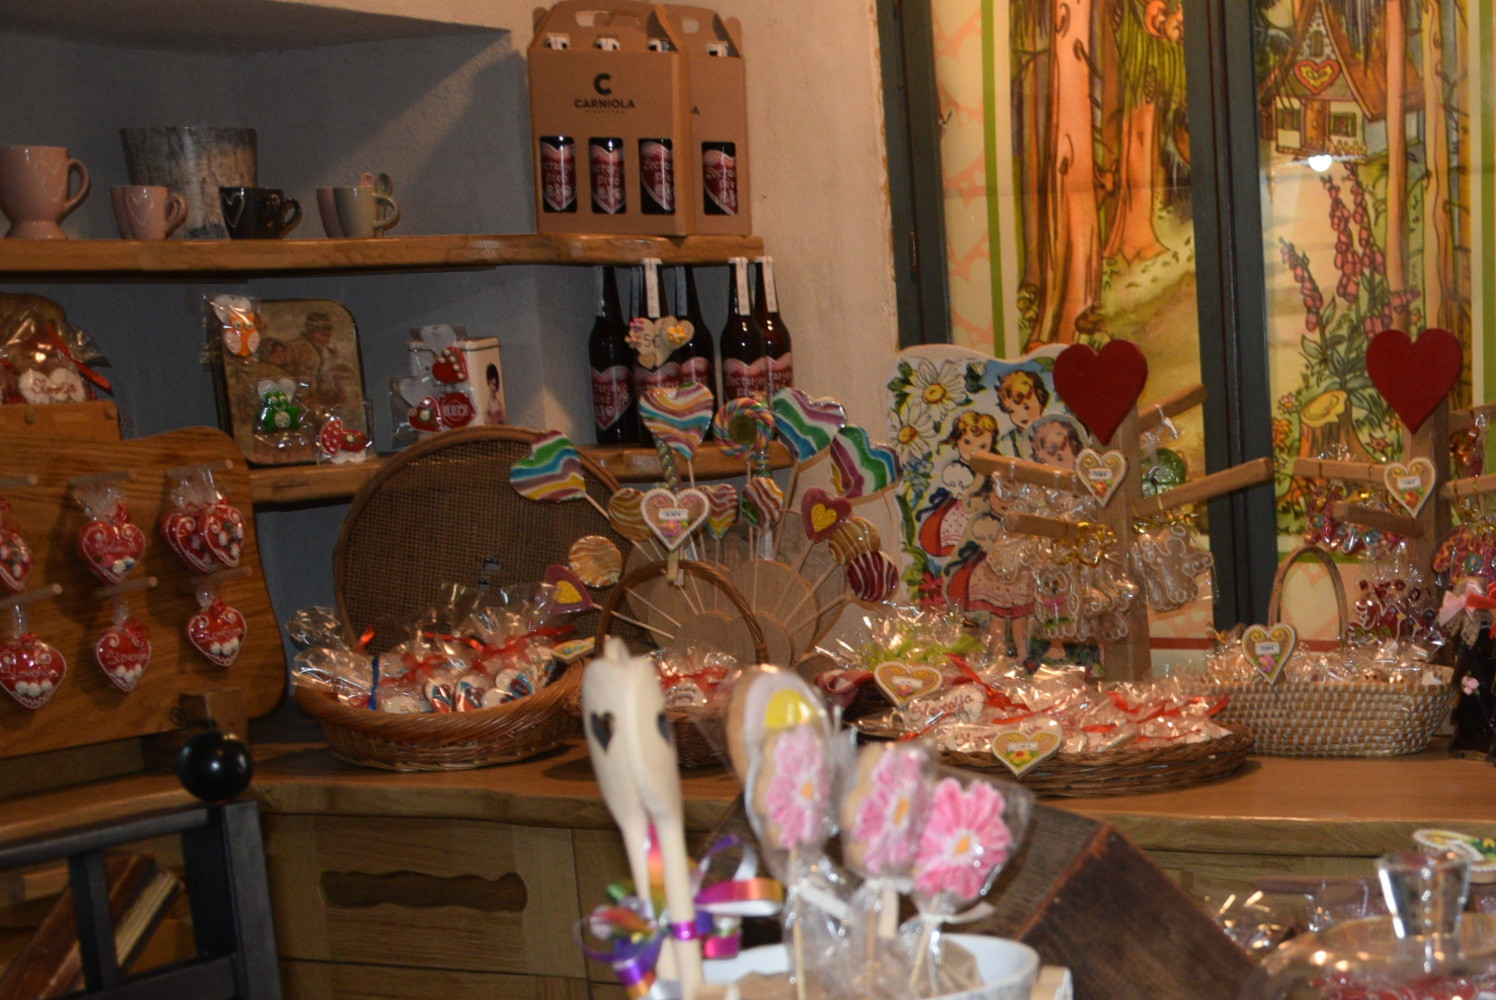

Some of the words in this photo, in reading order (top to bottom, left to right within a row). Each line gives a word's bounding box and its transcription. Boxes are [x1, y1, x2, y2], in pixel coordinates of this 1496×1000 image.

[594, 73, 612, 95] C
[574, 98, 635, 109] CARNIOLA
[643, 333, 660, 349] 5€
